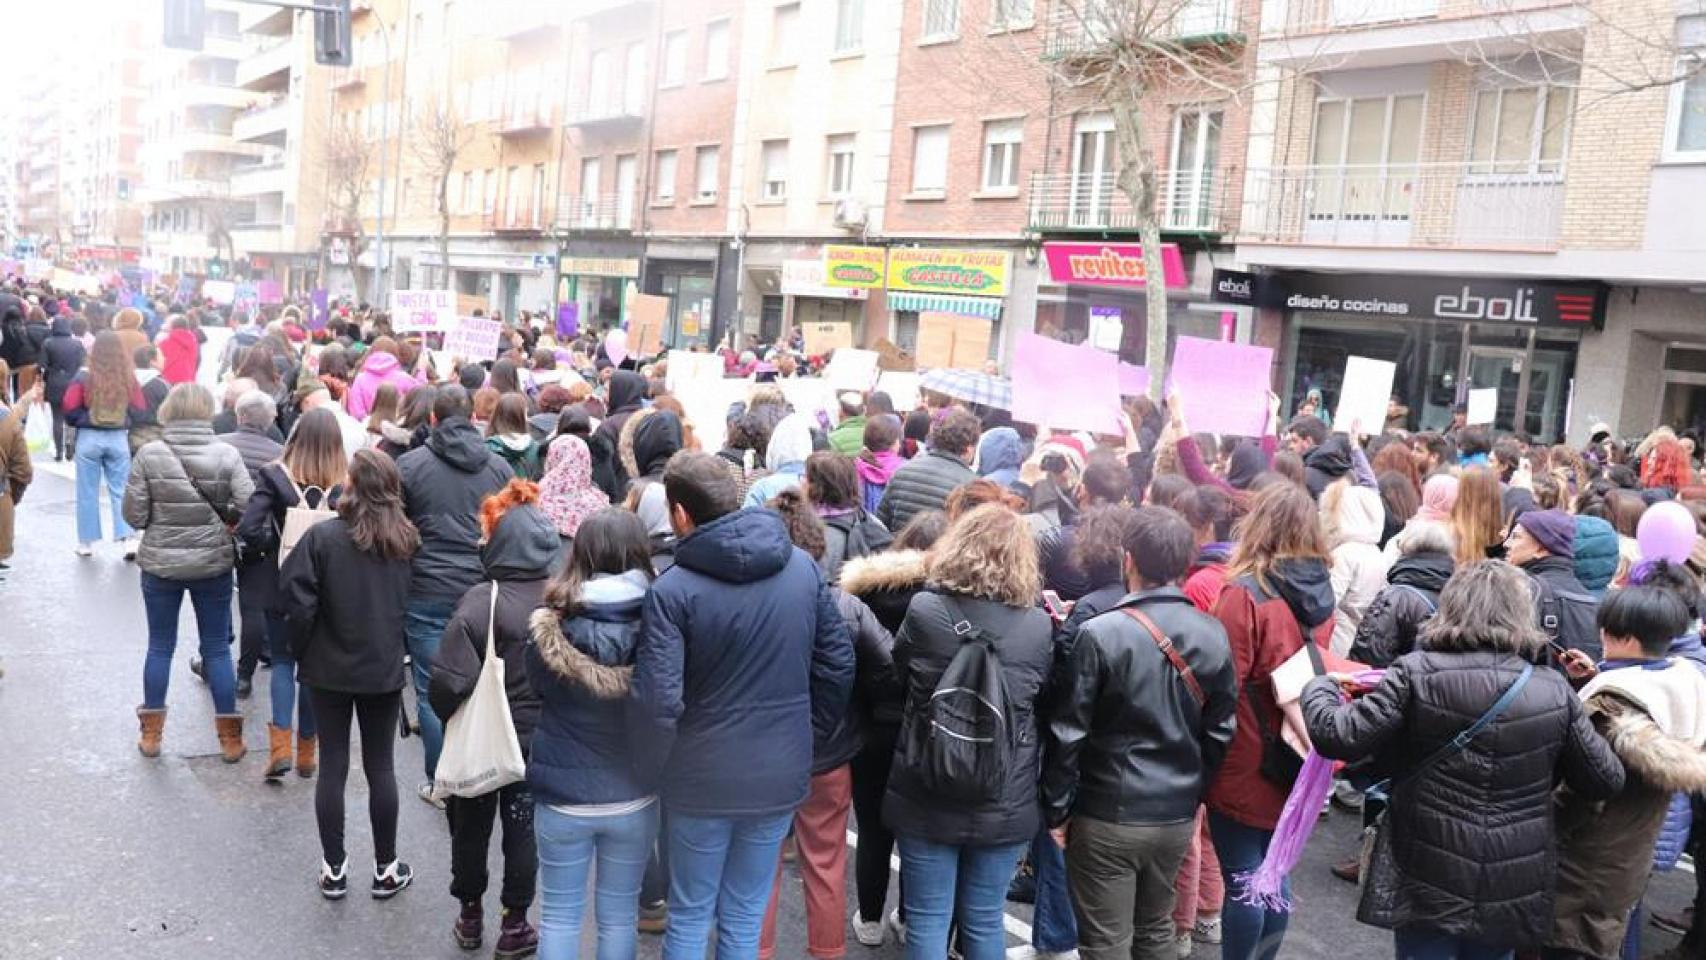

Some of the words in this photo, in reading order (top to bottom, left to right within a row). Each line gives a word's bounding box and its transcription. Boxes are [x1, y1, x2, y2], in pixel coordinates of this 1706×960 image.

[908, 268, 984, 287] CASTILLA
[1219, 277, 1250, 293] eboli
[1287, 294, 1339, 310] diseño
[1342, 298, 1409, 315] cocinas
[1434, 286, 1538, 322] eboli
